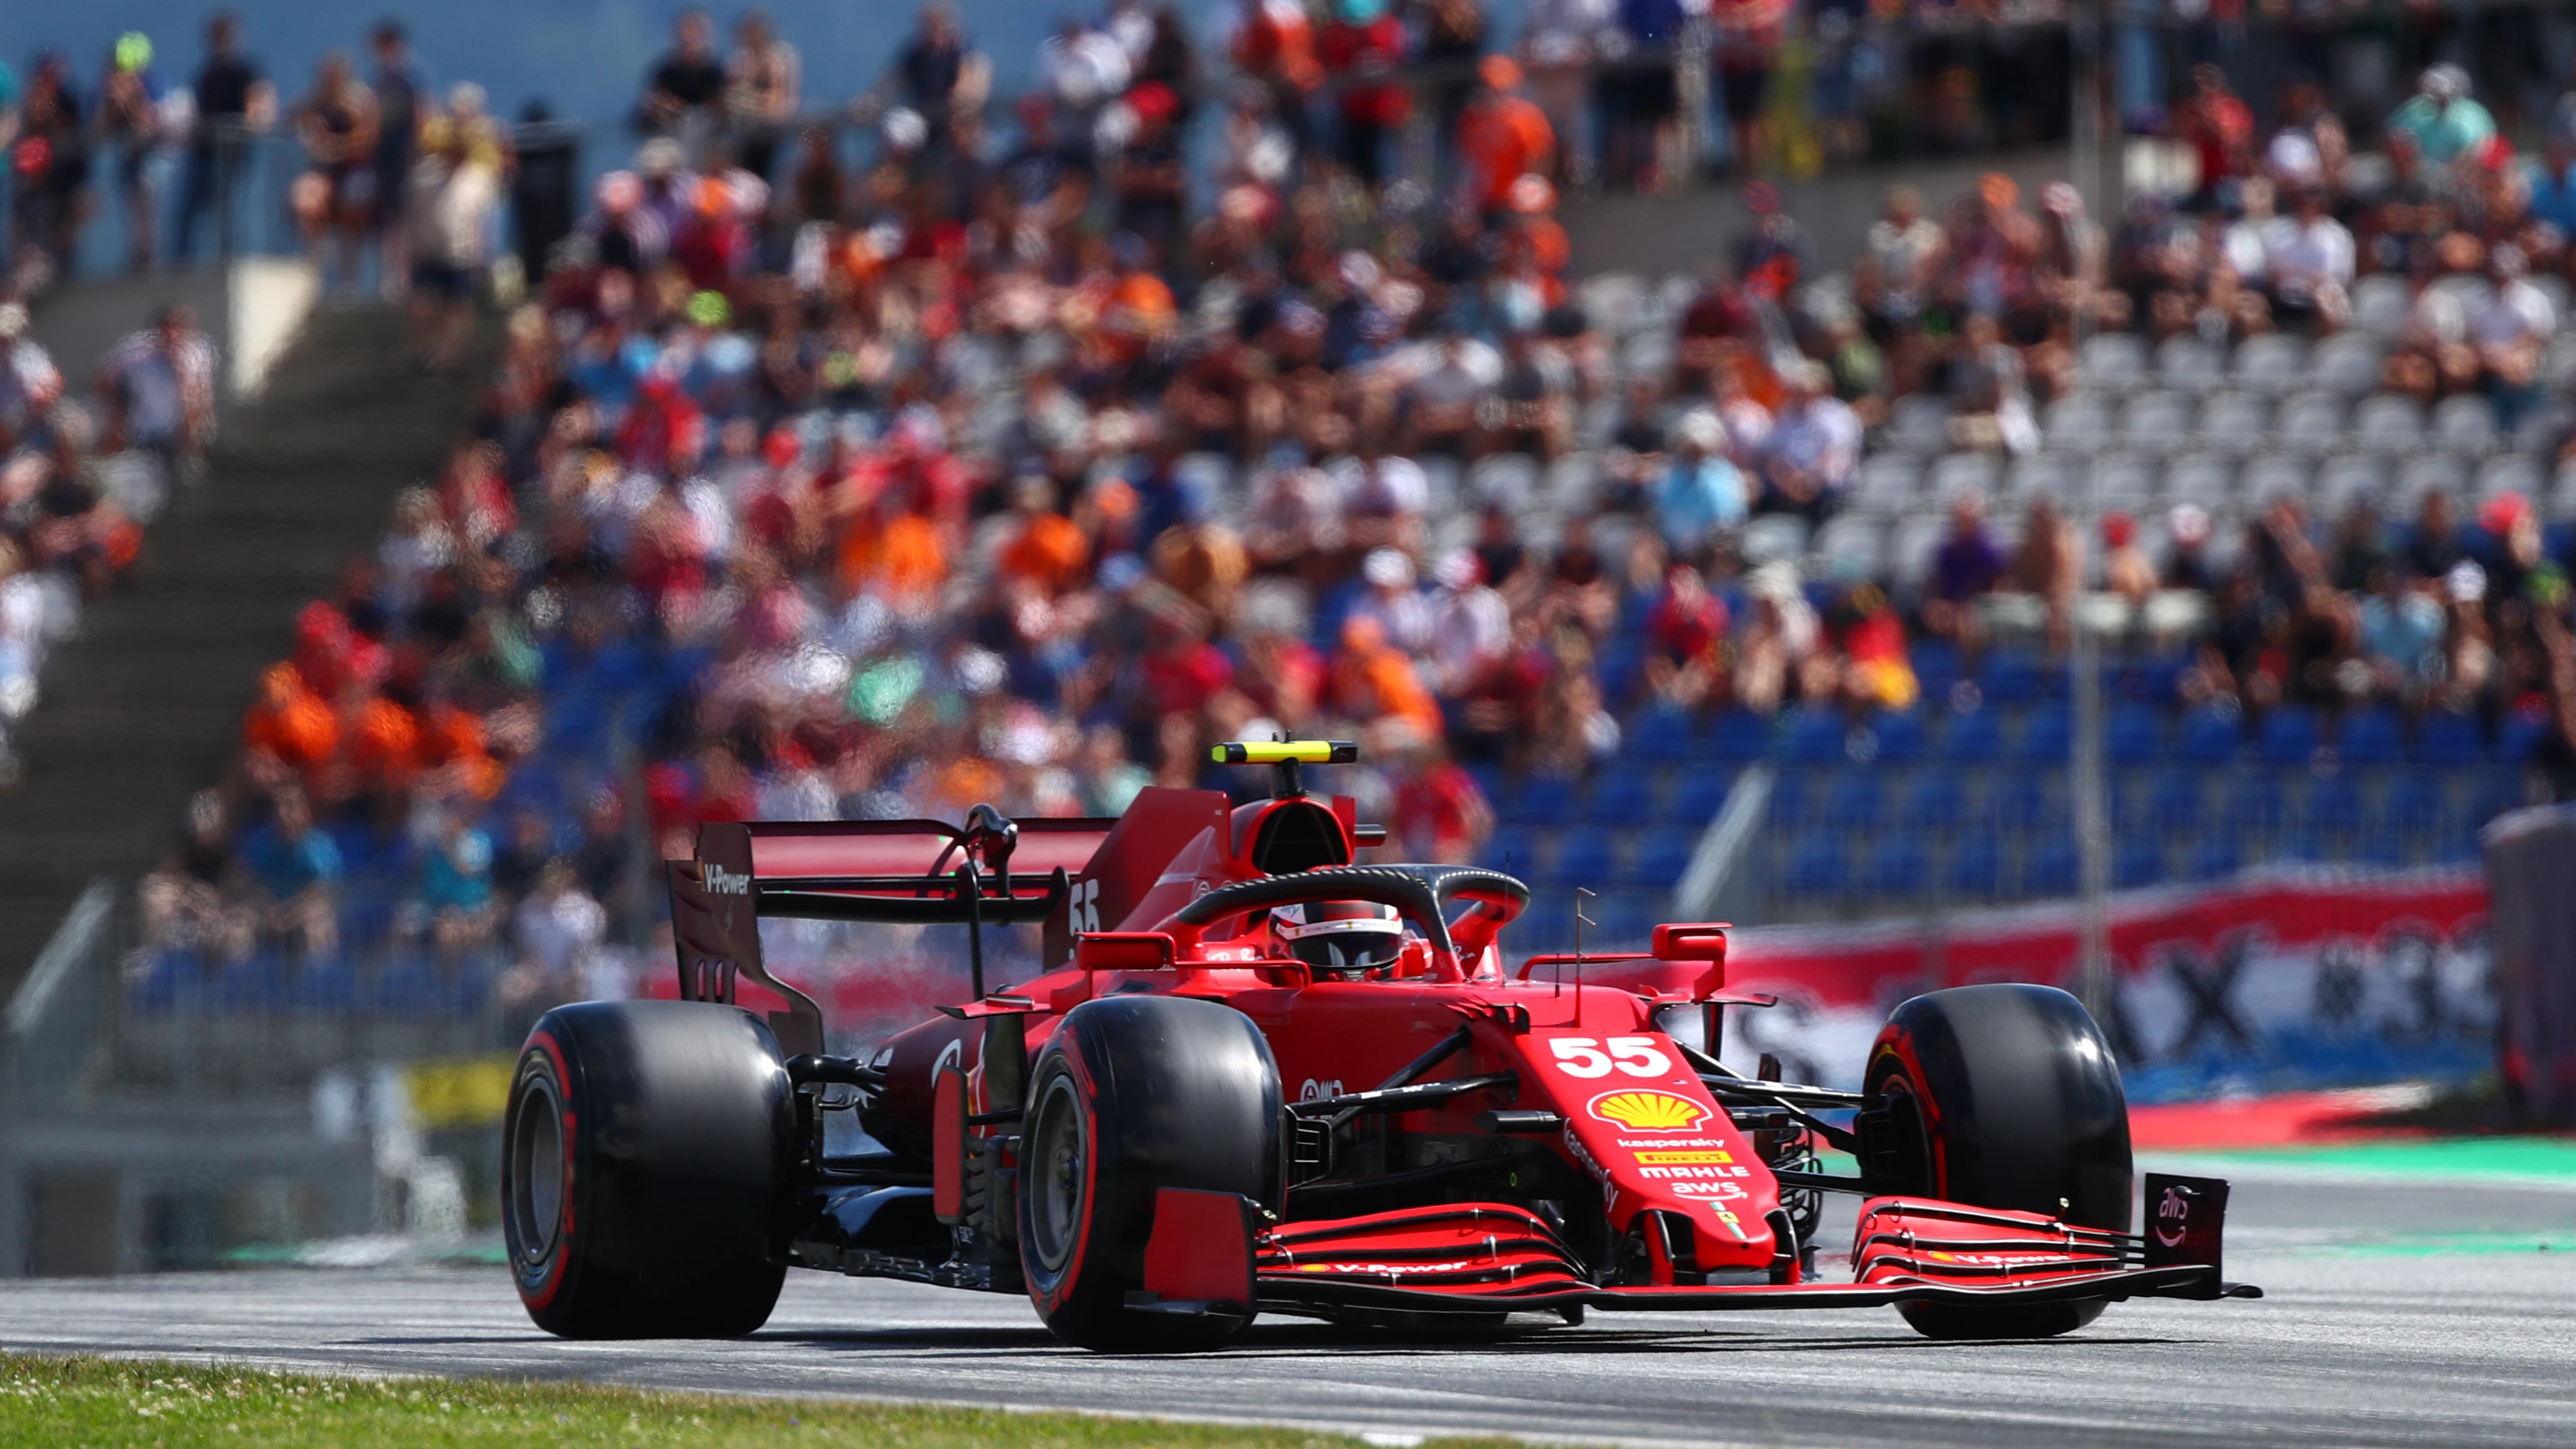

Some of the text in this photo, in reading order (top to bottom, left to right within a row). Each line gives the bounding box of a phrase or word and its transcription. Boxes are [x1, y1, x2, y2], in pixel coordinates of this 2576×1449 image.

[704, 863, 750, 895] V-Power
[1549, 1036, 1672, 1078] 55
[1617, 1138, 1725, 1148] kaspersky
[1638, 1166, 1751, 1178] MAHLE
[1670, 1181, 1742, 1194] aws
[1954, 1254, 2071, 1265] V-Power
[1334, 1261, 1468, 1272] V-Power
